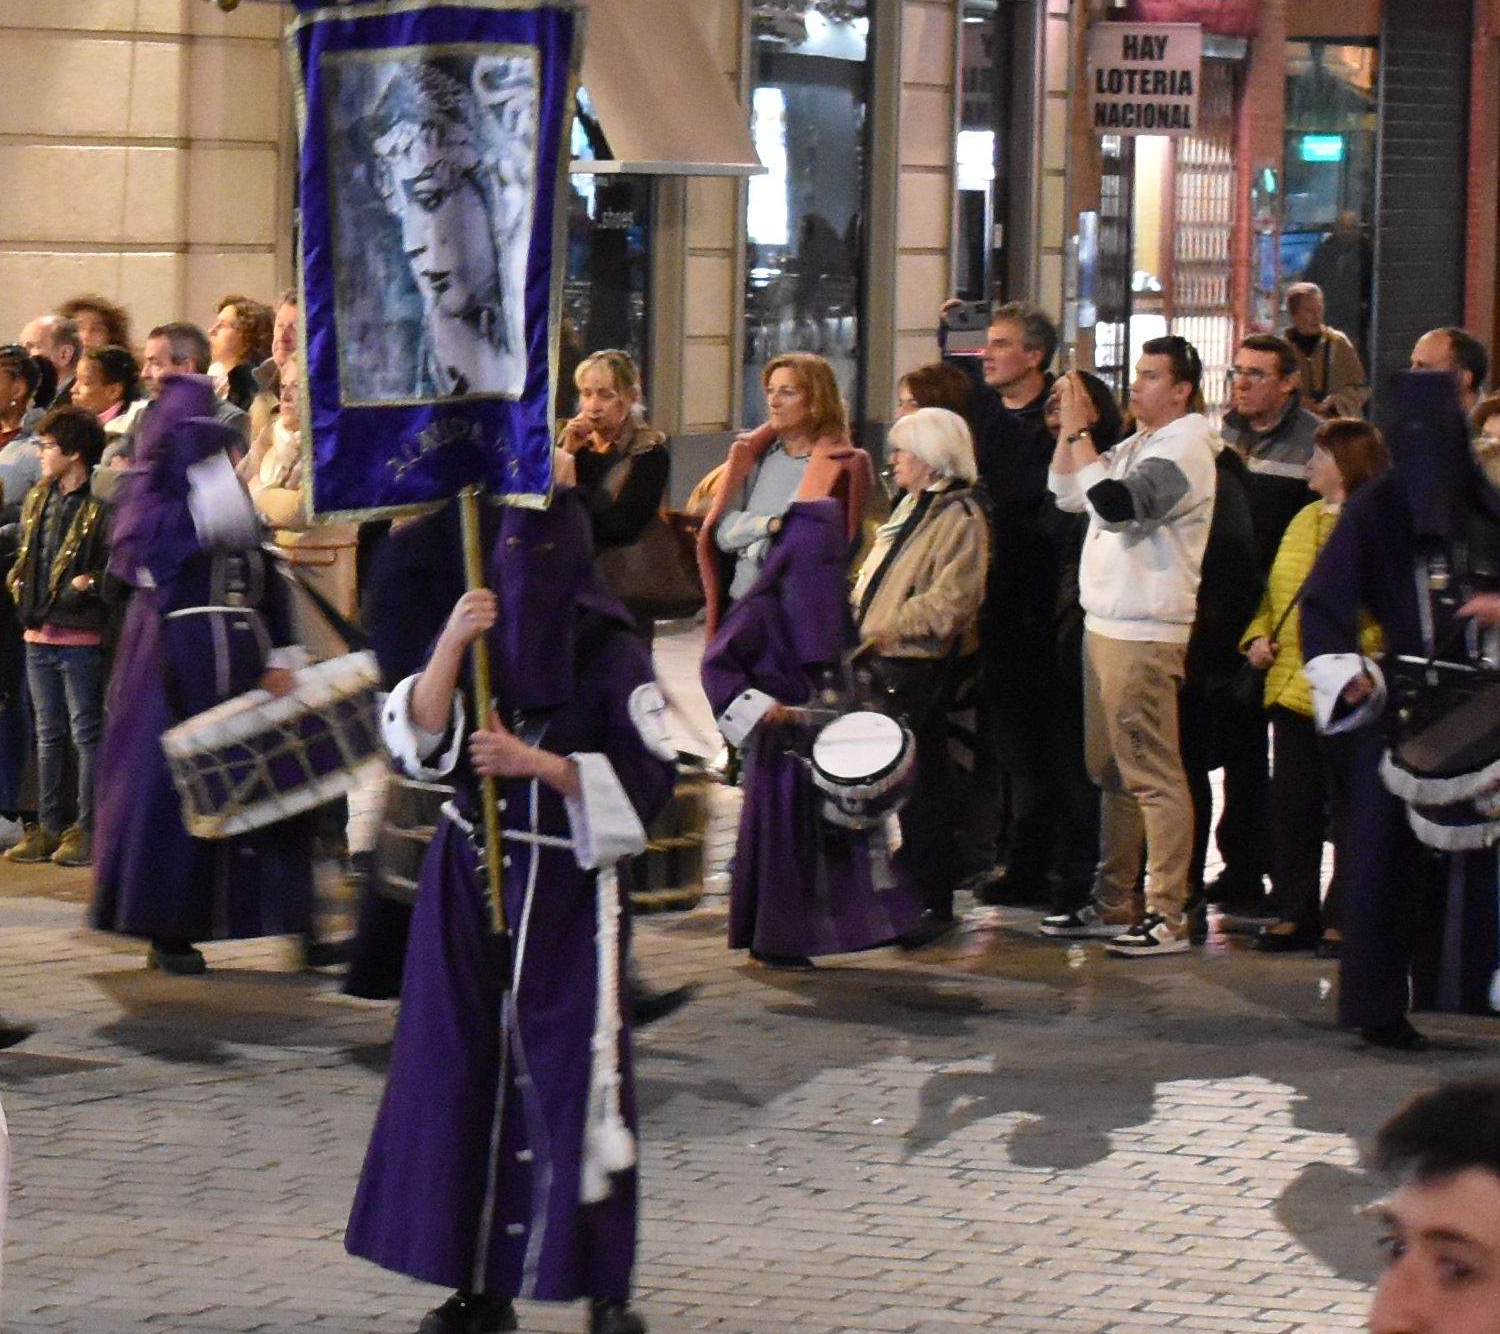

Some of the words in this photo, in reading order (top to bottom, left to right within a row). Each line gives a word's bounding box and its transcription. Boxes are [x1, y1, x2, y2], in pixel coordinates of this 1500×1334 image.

[1122, 33, 1169, 61] HAY
[1095, 69, 1194, 96] LOTERIA
[1093, 102, 1192, 129] NACIONAL
